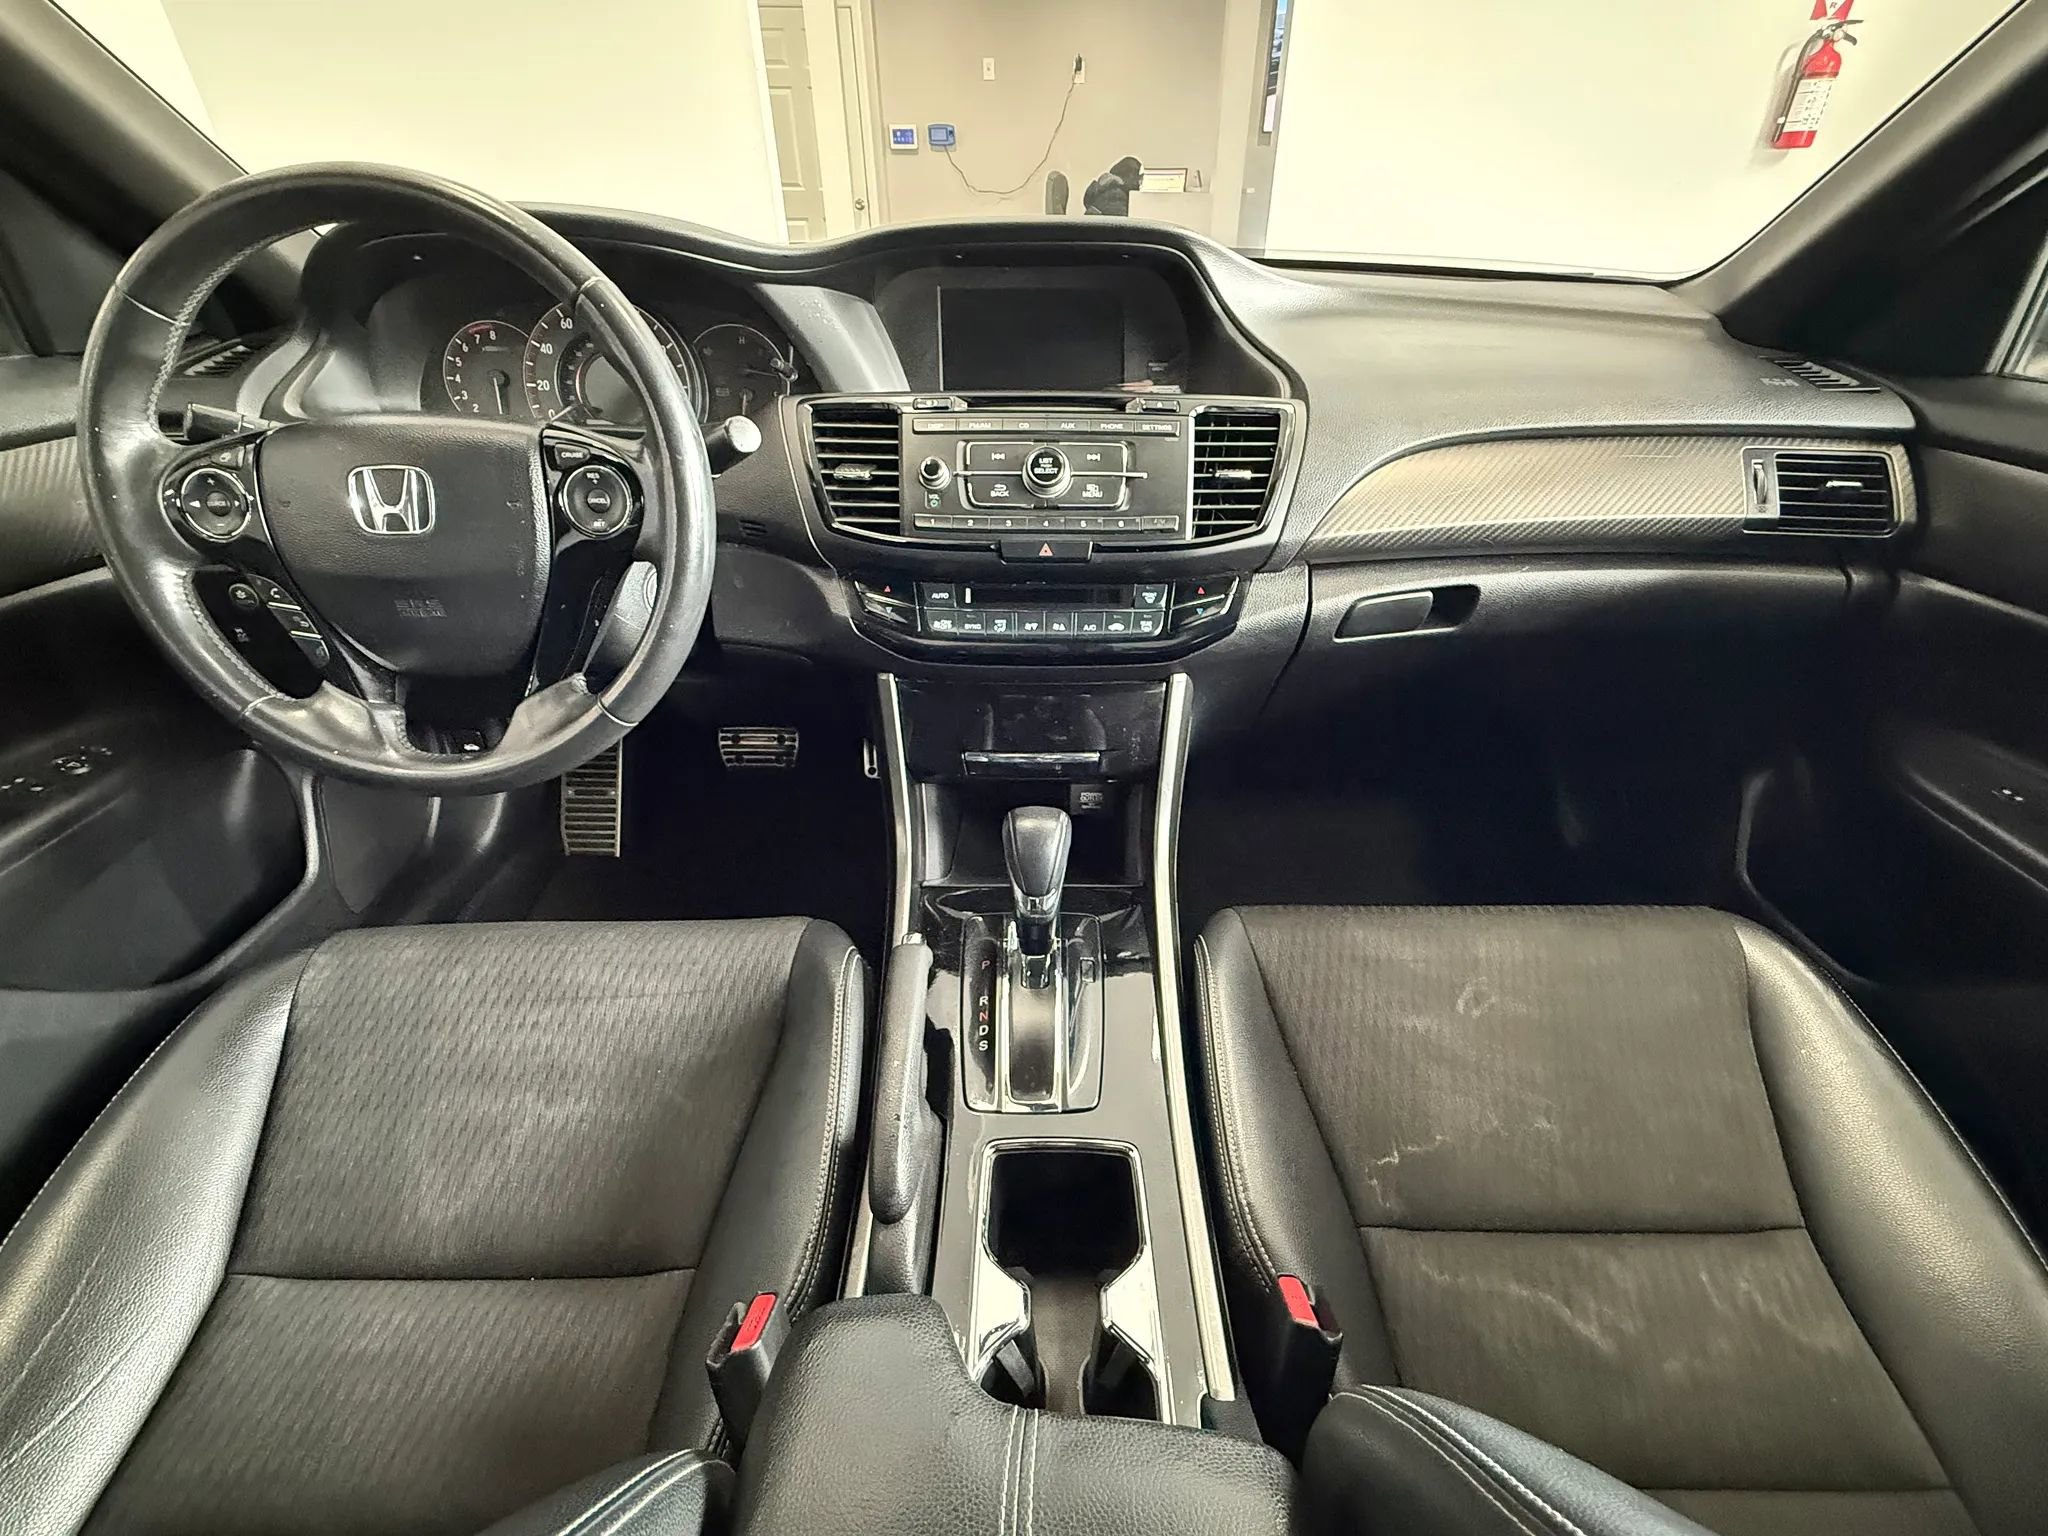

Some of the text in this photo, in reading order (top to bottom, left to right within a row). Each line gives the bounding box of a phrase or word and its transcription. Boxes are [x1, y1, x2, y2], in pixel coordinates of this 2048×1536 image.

[560, 317, 573, 330] 60
[474, 334, 480, 345] 7
[489, 330, 497, 341] 8
[738, 336, 746, 345] H
[462, 342, 469, 353] 6
[540, 343, 553, 355] 40
[455, 356, 463, 368] 5
[455, 373, 462, 384] 4
[536, 379, 550, 392] 20
[461, 390, 469, 401] 3
[472, 403, 480, 413] 2
[1060, 422, 1076, 430] AUX
[990, 490, 1010, 498] BACK
[1082, 490, 1103, 498] MENU
[930, 518, 936, 526] 1
[967, 519, 974, 527] 2
[1005, 519, 1012, 527] 3
[1042, 520, 1049, 528] 4
[931, 592, 950, 600] AUTO
[1083, 624, 1097, 632] A/C
[981, 960, 990, 970] P
[979, 996, 989, 1007] R
[979, 1012, 989, 1023] N
[979, 1025, 989, 1036] D
[978, 1039, 989, 1051] S
